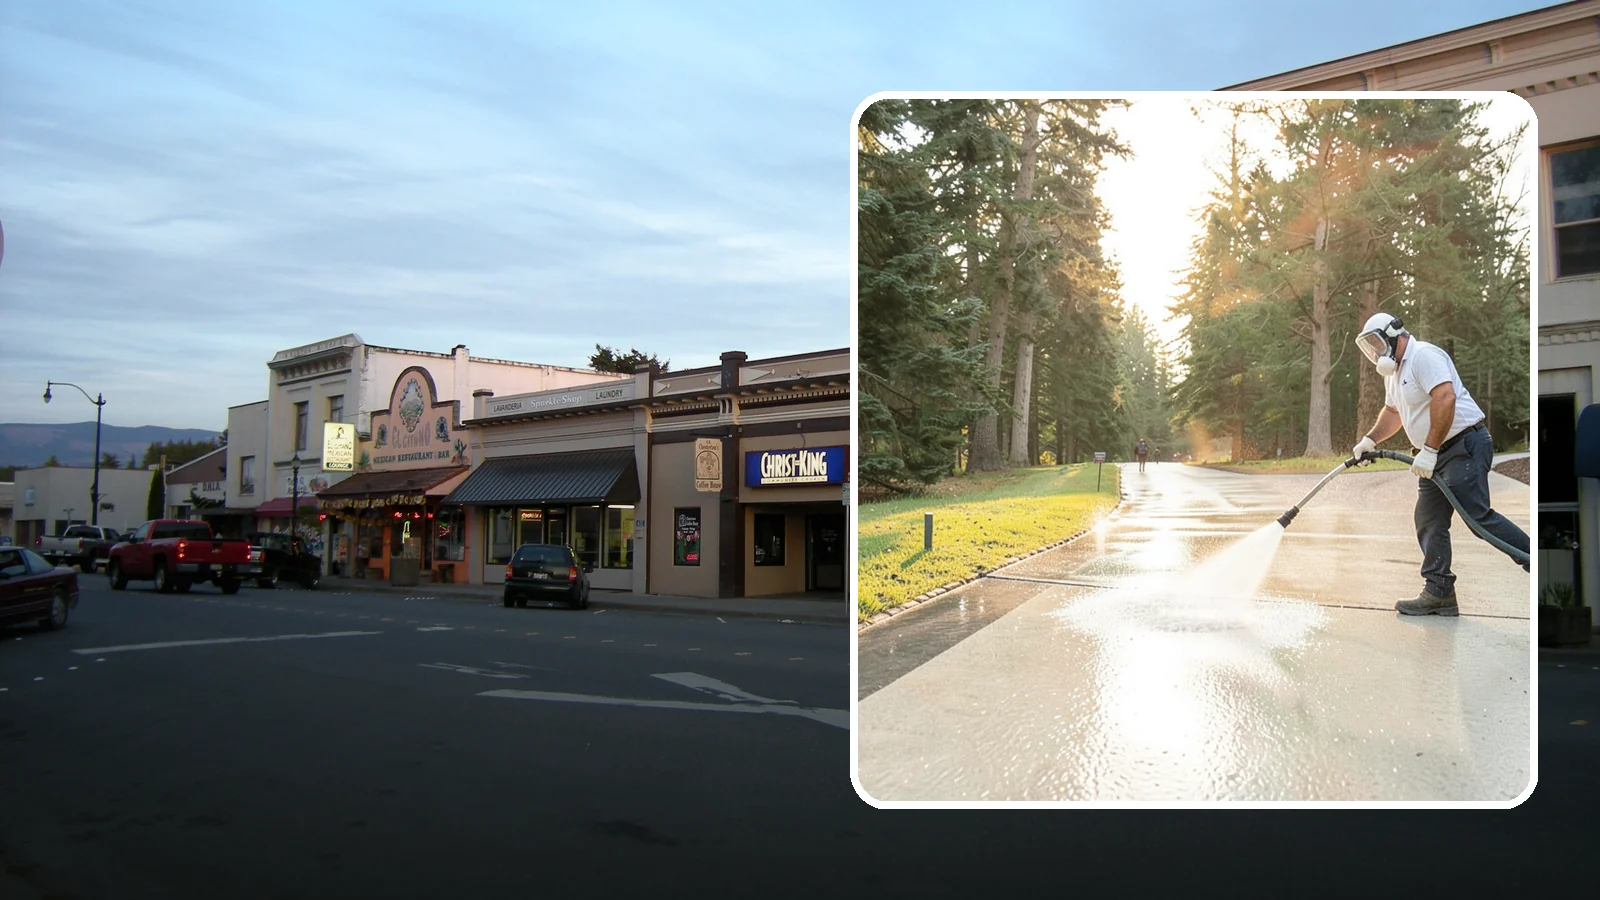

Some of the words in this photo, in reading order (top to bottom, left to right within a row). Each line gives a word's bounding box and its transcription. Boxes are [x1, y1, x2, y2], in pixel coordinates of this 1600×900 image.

[562, 395, 582, 405] Shop
[596, 389, 623, 400] LAUNDRY
[493, 402, 522, 412] LAVANDERIA
[373, 454, 398, 464] MEXICAN
[398, 451, 433, 462] RESTAURANT
[437, 450, 450, 459] BAR
[760, 452, 797, 478] CHRIST
[799, 450, 827, 476] KING
